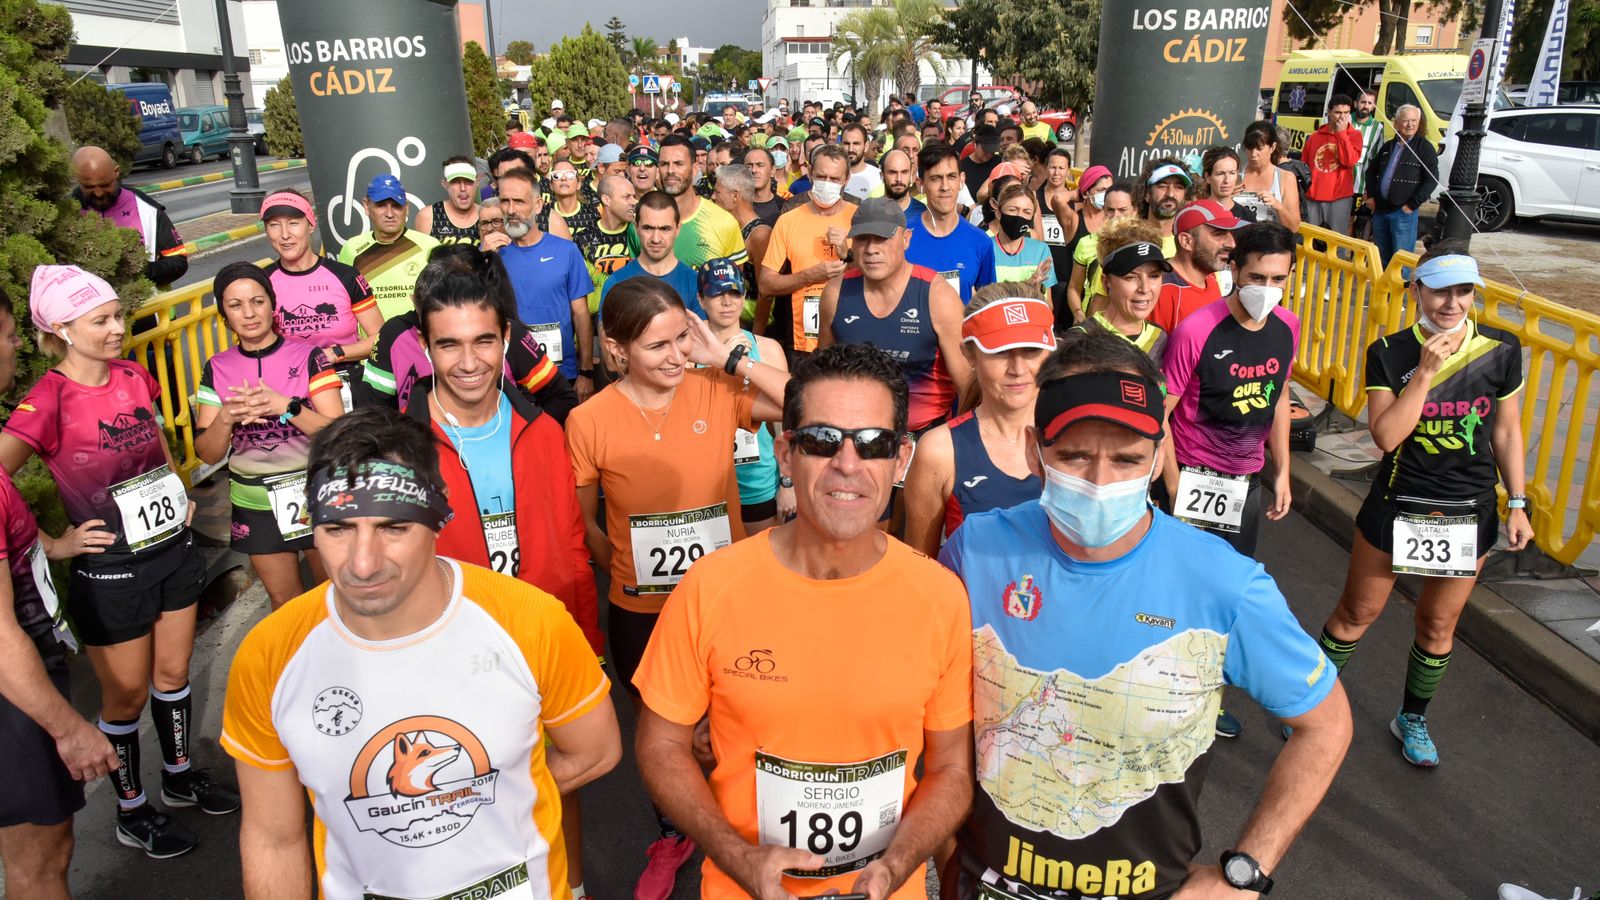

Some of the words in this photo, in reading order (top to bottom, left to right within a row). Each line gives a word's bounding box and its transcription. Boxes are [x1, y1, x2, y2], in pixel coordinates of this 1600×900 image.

[1132, 9, 1177, 31] LOS
[1184, 6, 1269, 31] BARRIOS
[286, 41, 313, 65] LOS
[316, 35, 427, 63] BARRIOS
[1163, 33, 1248, 63] CÁDIZ
[1287, 66, 1329, 75] AMBULANCIA
[309, 65, 397, 97] CÁDIZ
[1195, 126, 1216, 146] BTT
[374, 292, 407, 300] ECADERO
[376, 284, 415, 292] TESORILLO
[1232, 381, 1262, 399] QUE
[1232, 397, 1267, 415] TU
[1422, 396, 1491, 418] ORRO
[1185, 488, 1229, 517] 276
[137, 495, 176, 531] 128
[667, 526, 696, 538] NURIA
[1405, 537, 1451, 563] 233
[88, 571, 135, 580] LURBEL
[764, 762, 839, 782] BORRIQUÍN
[837, 753, 905, 784] TRAIL
[471, 775, 494, 787] 2018
[426, 786, 482, 807] TRAIL
[803, 786, 860, 801] SERGIO
[797, 800, 832, 810] MORENO
[435, 821, 461, 835] 830D
[780, 810, 863, 855] 189
[835, 852, 856, 863] BIKES
